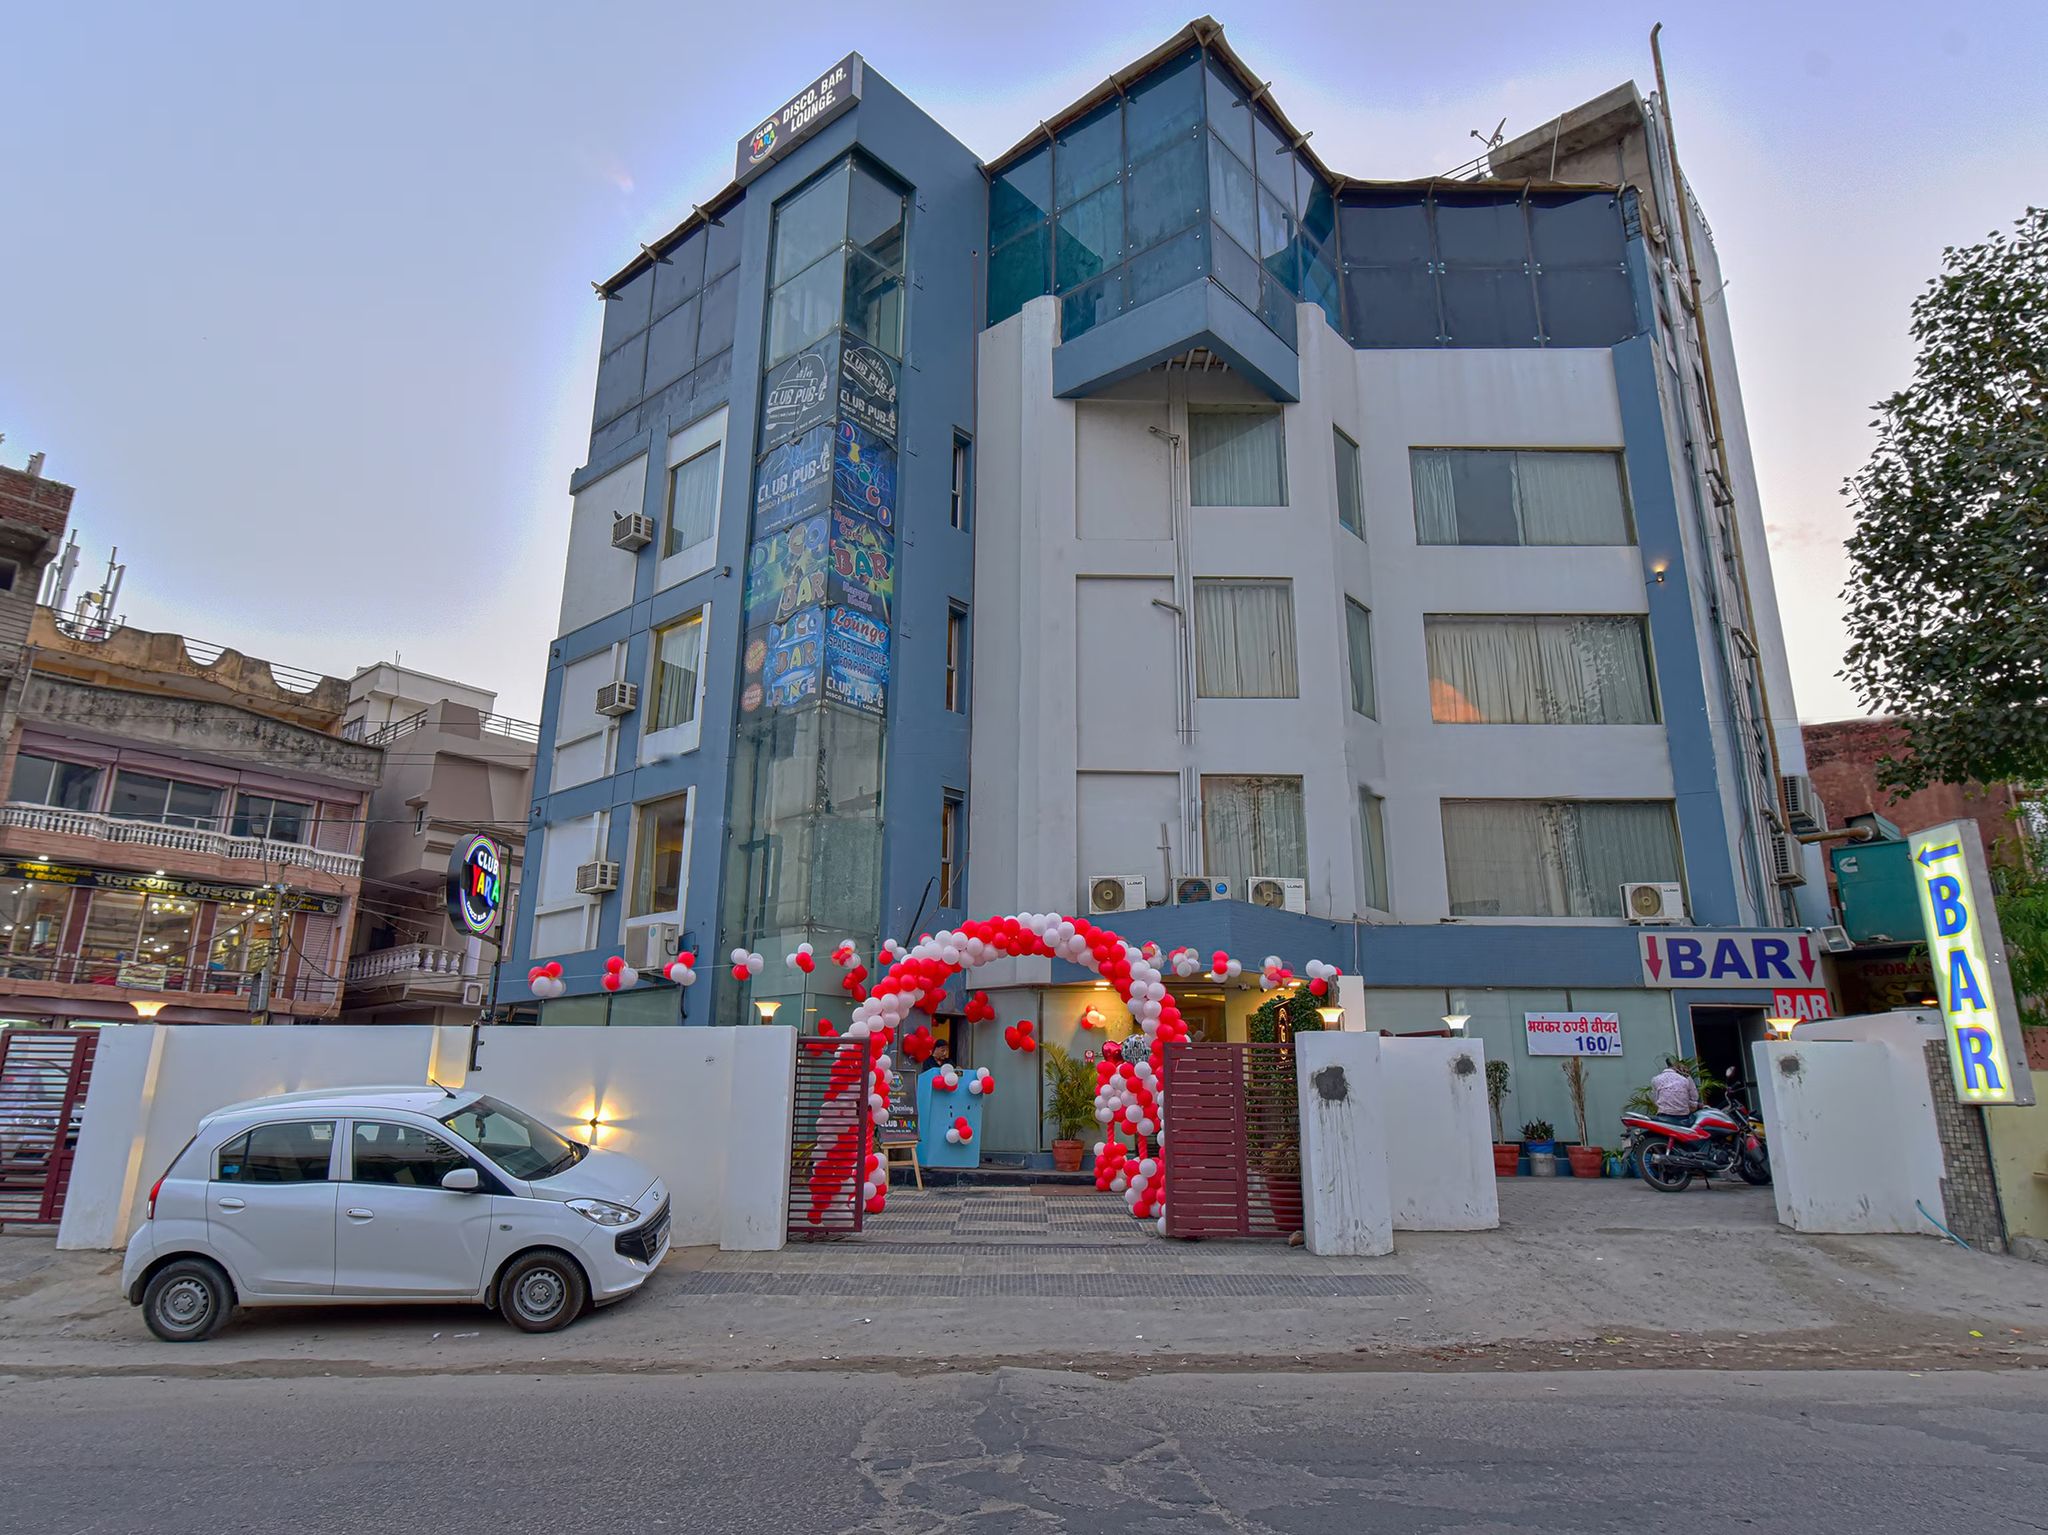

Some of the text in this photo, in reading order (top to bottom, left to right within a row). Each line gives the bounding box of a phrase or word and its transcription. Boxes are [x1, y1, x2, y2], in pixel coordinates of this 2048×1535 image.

[783, 67, 847, 124] DISCO. BAR.
[791, 90, 836, 133] LOUNGE.
[753, 130, 776, 154] YARA
[756, 124, 773, 140] CLUB
[768, 374, 827, 406] CLUB PUB-G
[844, 349, 896, 402] CLUB PUB-G
[841, 389, 865, 411] CLUB
[868, 405, 896, 429] PUB-G
[757, 443, 830, 503] CLUB PUB-G
[833, 548, 890, 581] BAR
[781, 571, 826, 611] BAR
[832, 607, 887, 642] Lounge
[775, 641, 817, 675] BAR
[828, 634, 887, 666] SPACE AVAILABLE
[840, 656, 853, 670] FOR
[826, 676, 852, 695] CLUB
[478, 851, 499, 876] CLUB
[95, 873, 184, 892] राजस्थान
[472, 864, 500, 907] YARA
[1666, 938, 1797, 980] BAR
[1928, 875, 2004, 1090] BAR
[1775, 994, 1830, 1019] BAR
[1527, 1016, 1561, 1033] भयंकर
[1562, 1016, 1589, 1033] ठण्डी
[1575, 1036, 1621, 1053] 160/-
[888, 1103, 914, 1114] Opening
[899, 1119, 917, 1130] YARA
